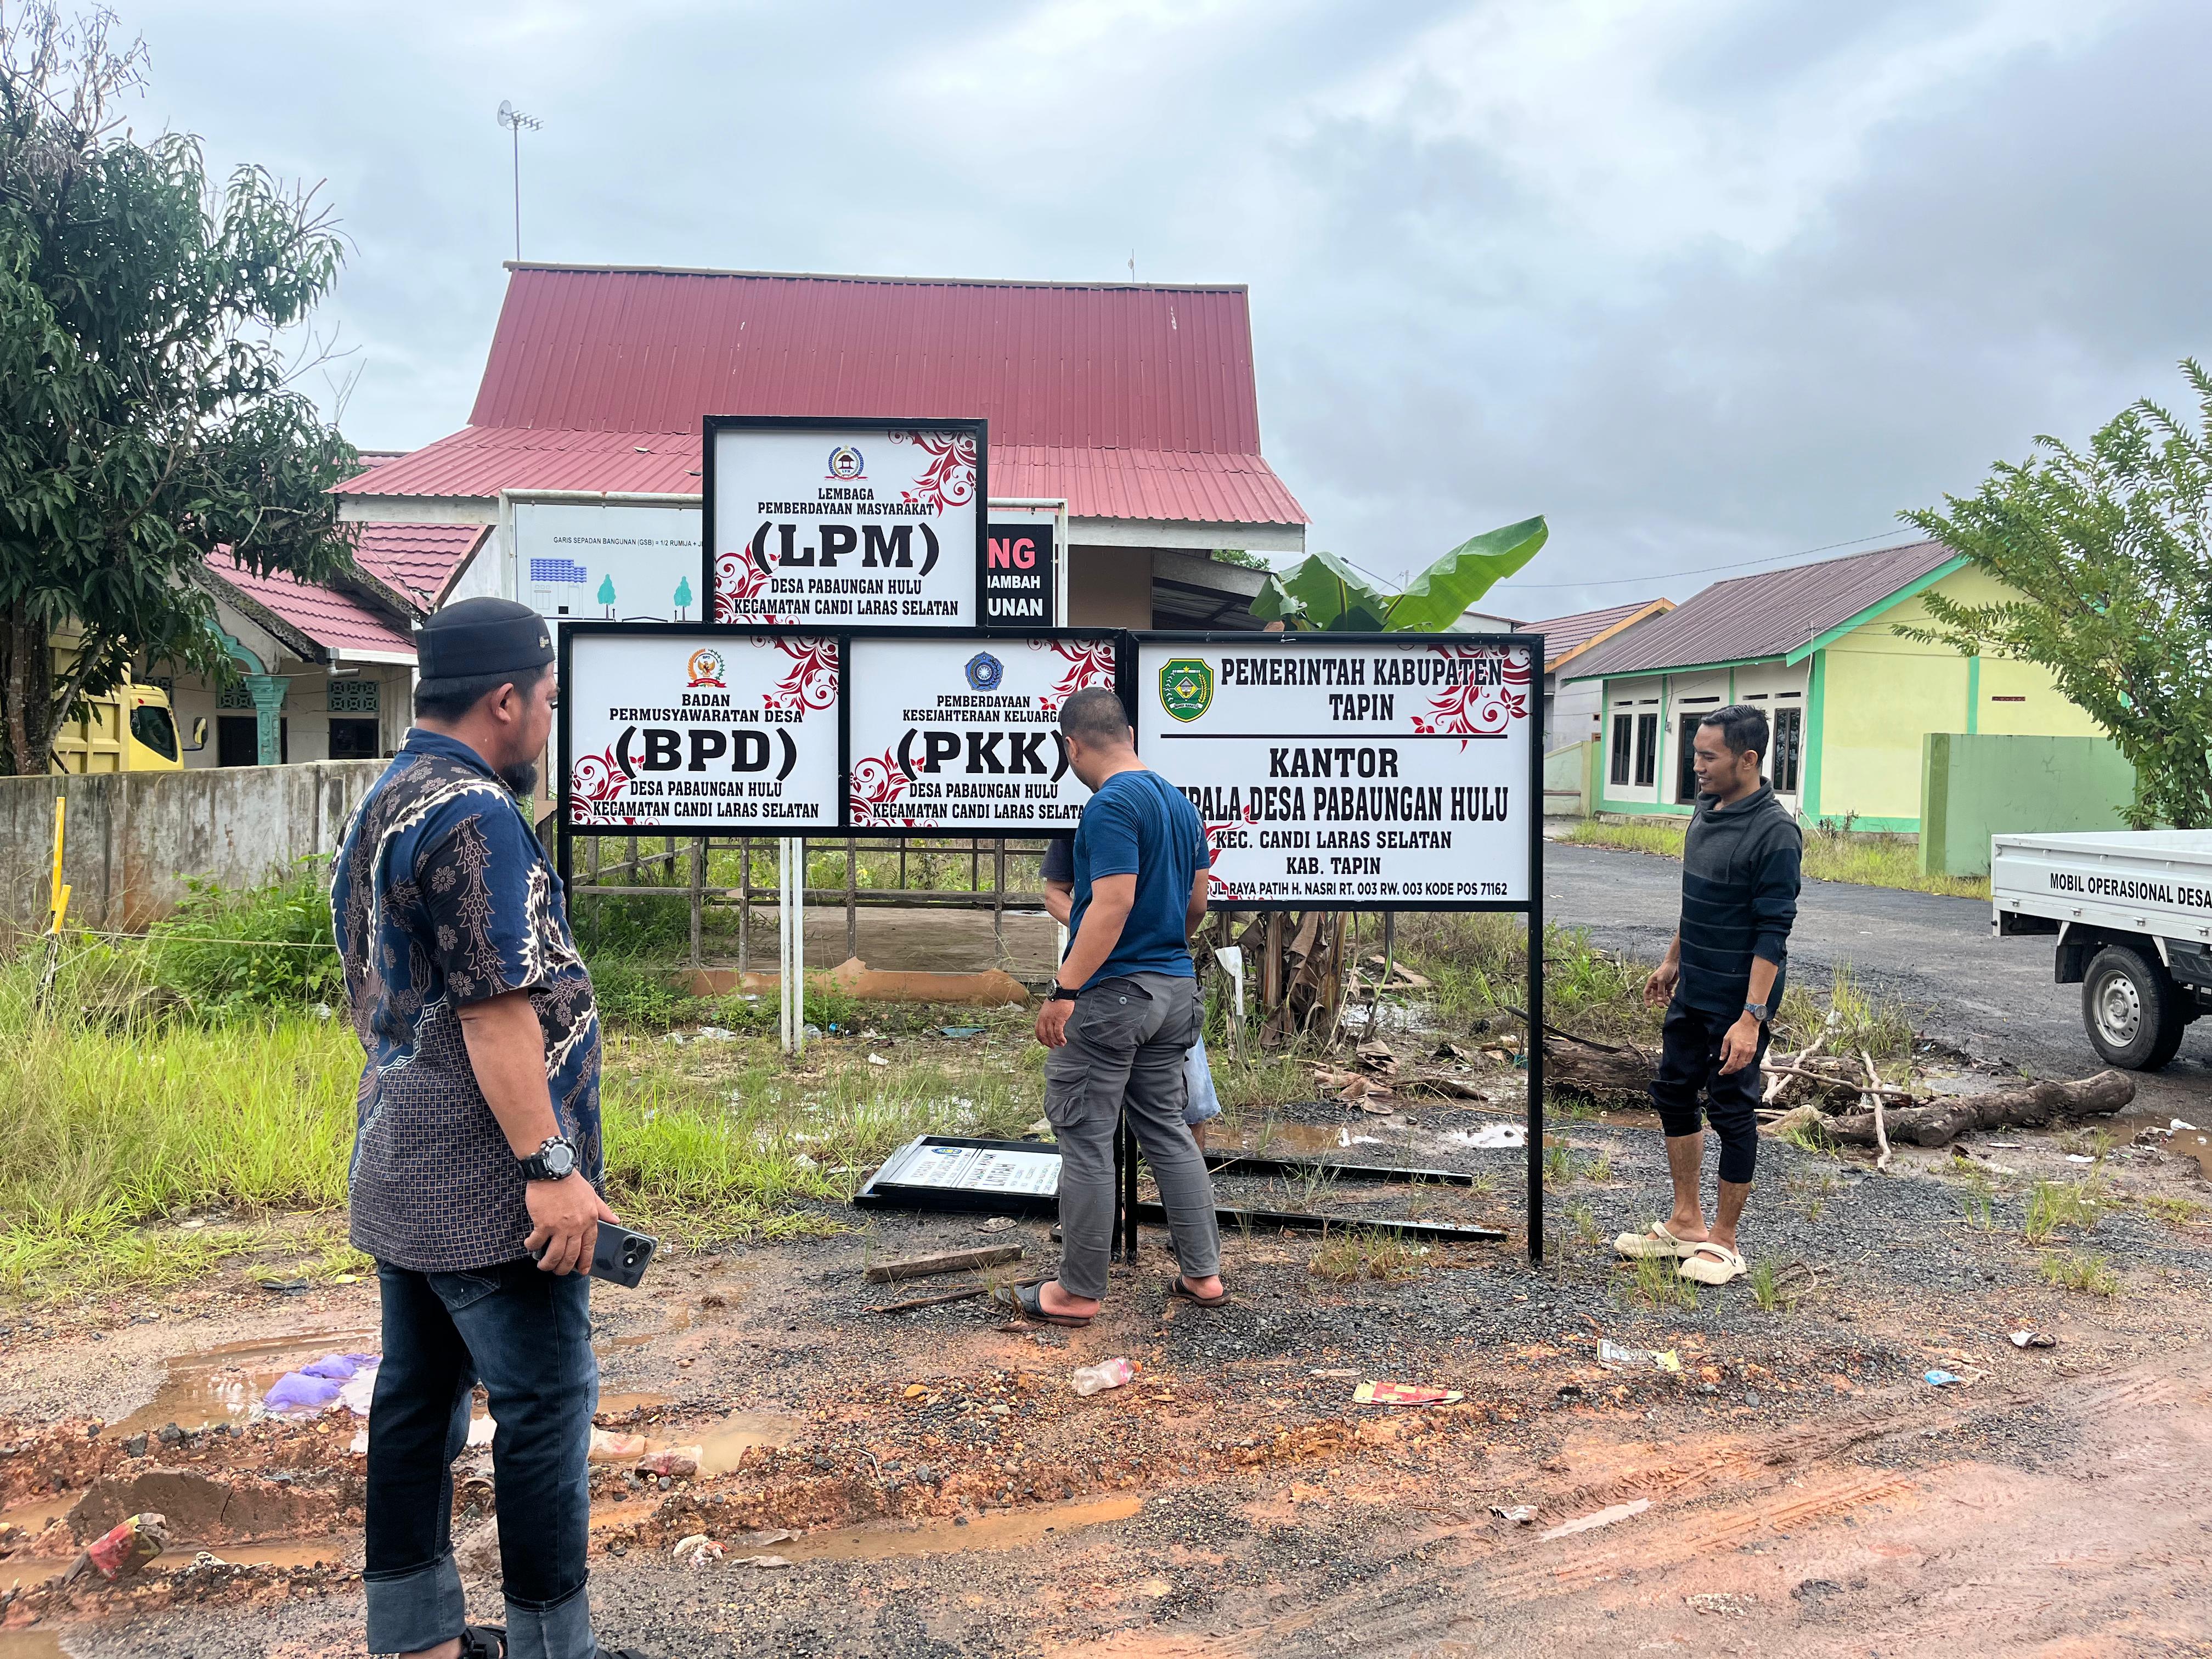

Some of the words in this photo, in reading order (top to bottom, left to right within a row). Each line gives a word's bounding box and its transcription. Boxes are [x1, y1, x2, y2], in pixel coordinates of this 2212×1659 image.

[819, 488, 874, 500] LEMBAGA
[758, 503, 852, 514] PEMBERDAYAAN
[857, 501, 934, 515] MASYARAKAT
[752, 521, 939, 577] (LPM)
[989, 538, 1035, 569] NG
[771, 579, 804, 593] DESA
[809, 579, 883, 594] PABAUNGAN
[888, 580, 921, 594] HULU
[734, 599, 810, 614] KECAMATAN
[815, 600, 852, 614] CANDI
[857, 600, 897, 615] LARAS
[902, 601, 958, 615] SELATAN
[988, 598, 1042, 616] UNAN
[1222, 659, 1364, 685] PEMERINTAH
[1374, 659, 1503, 685] KABUPATEN
[682, 694, 730, 706] BADAN
[938, 696, 1030, 707] PEMBERDAYAAN
[1329, 694, 1393, 720] TAPIN
[610, 708, 759, 722] PERMUSYAWARATAN
[765, 709, 804, 723] DESA
[903, 710, 1000, 721] KESEJAHTERAAN
[1005, 710, 1060, 722] KELUARG
[614, 726, 797, 783] (BPD)
[898, 728, 1069, 783] (PKK)
[1270, 748, 1398, 777] KANTOR
[630, 781, 663, 795] DESA
[668, 781, 743, 796] PABAUNGAN
[749, 782, 782, 797] HULU
[910, 783, 941, 797] DESA
[946, 783, 1020, 798] PABAUNGAN
[1025, 784, 1058, 798] HULU
[592, 802, 669, 816] KECAMATAN
[675, 802, 712, 816] CANDI
[718, 803, 757, 817] LARAS
[763, 803, 819, 817] SELATAN
[872, 803, 947, 818] KECAMATAN
[952, 804, 989, 818] CANDI
[995, 804, 1034, 819] LARAS
[1039, 805, 1083, 820] SELATA
[1176, 787, 1242, 821] PALA
[1249, 786, 1305, 821] DESA
[1314, 786, 1442, 821] PABAUNGAN
[1451, 787, 1508, 821] HULU
[1214, 831, 1252, 848] KEC.
[1260, 831, 1310, 848] CANDI
[1317, 831, 1369, 848] LARAS
[1377, 831, 1451, 848] SELATAN
[1287, 857, 1323, 874] KAB.
[1331, 857, 1380, 874] TAPIN
[1212, 883, 1226, 895] JL.
[1230, 883, 1256, 895] RAYA
[1260, 882, 1288, 894] PATIH
[1293, 883, 1301, 894] H.
[1305, 883, 1335, 895] NASRI
[1340, 883, 1354, 895] RT.
[1358, 883, 1376, 895] 003
[1381, 883, 1399, 895] RW.
[1403, 883, 1422, 895] 003
[1426, 883, 1453, 895] KODE
[1458, 883, 1477, 895] POS
[1481, 883, 1506, 895] 71162
[2051, 873, 2084, 891] MOBIL
[2089, 877, 2173, 903] OPERASIONAL
[2179, 887, 2212, 908] DESA
